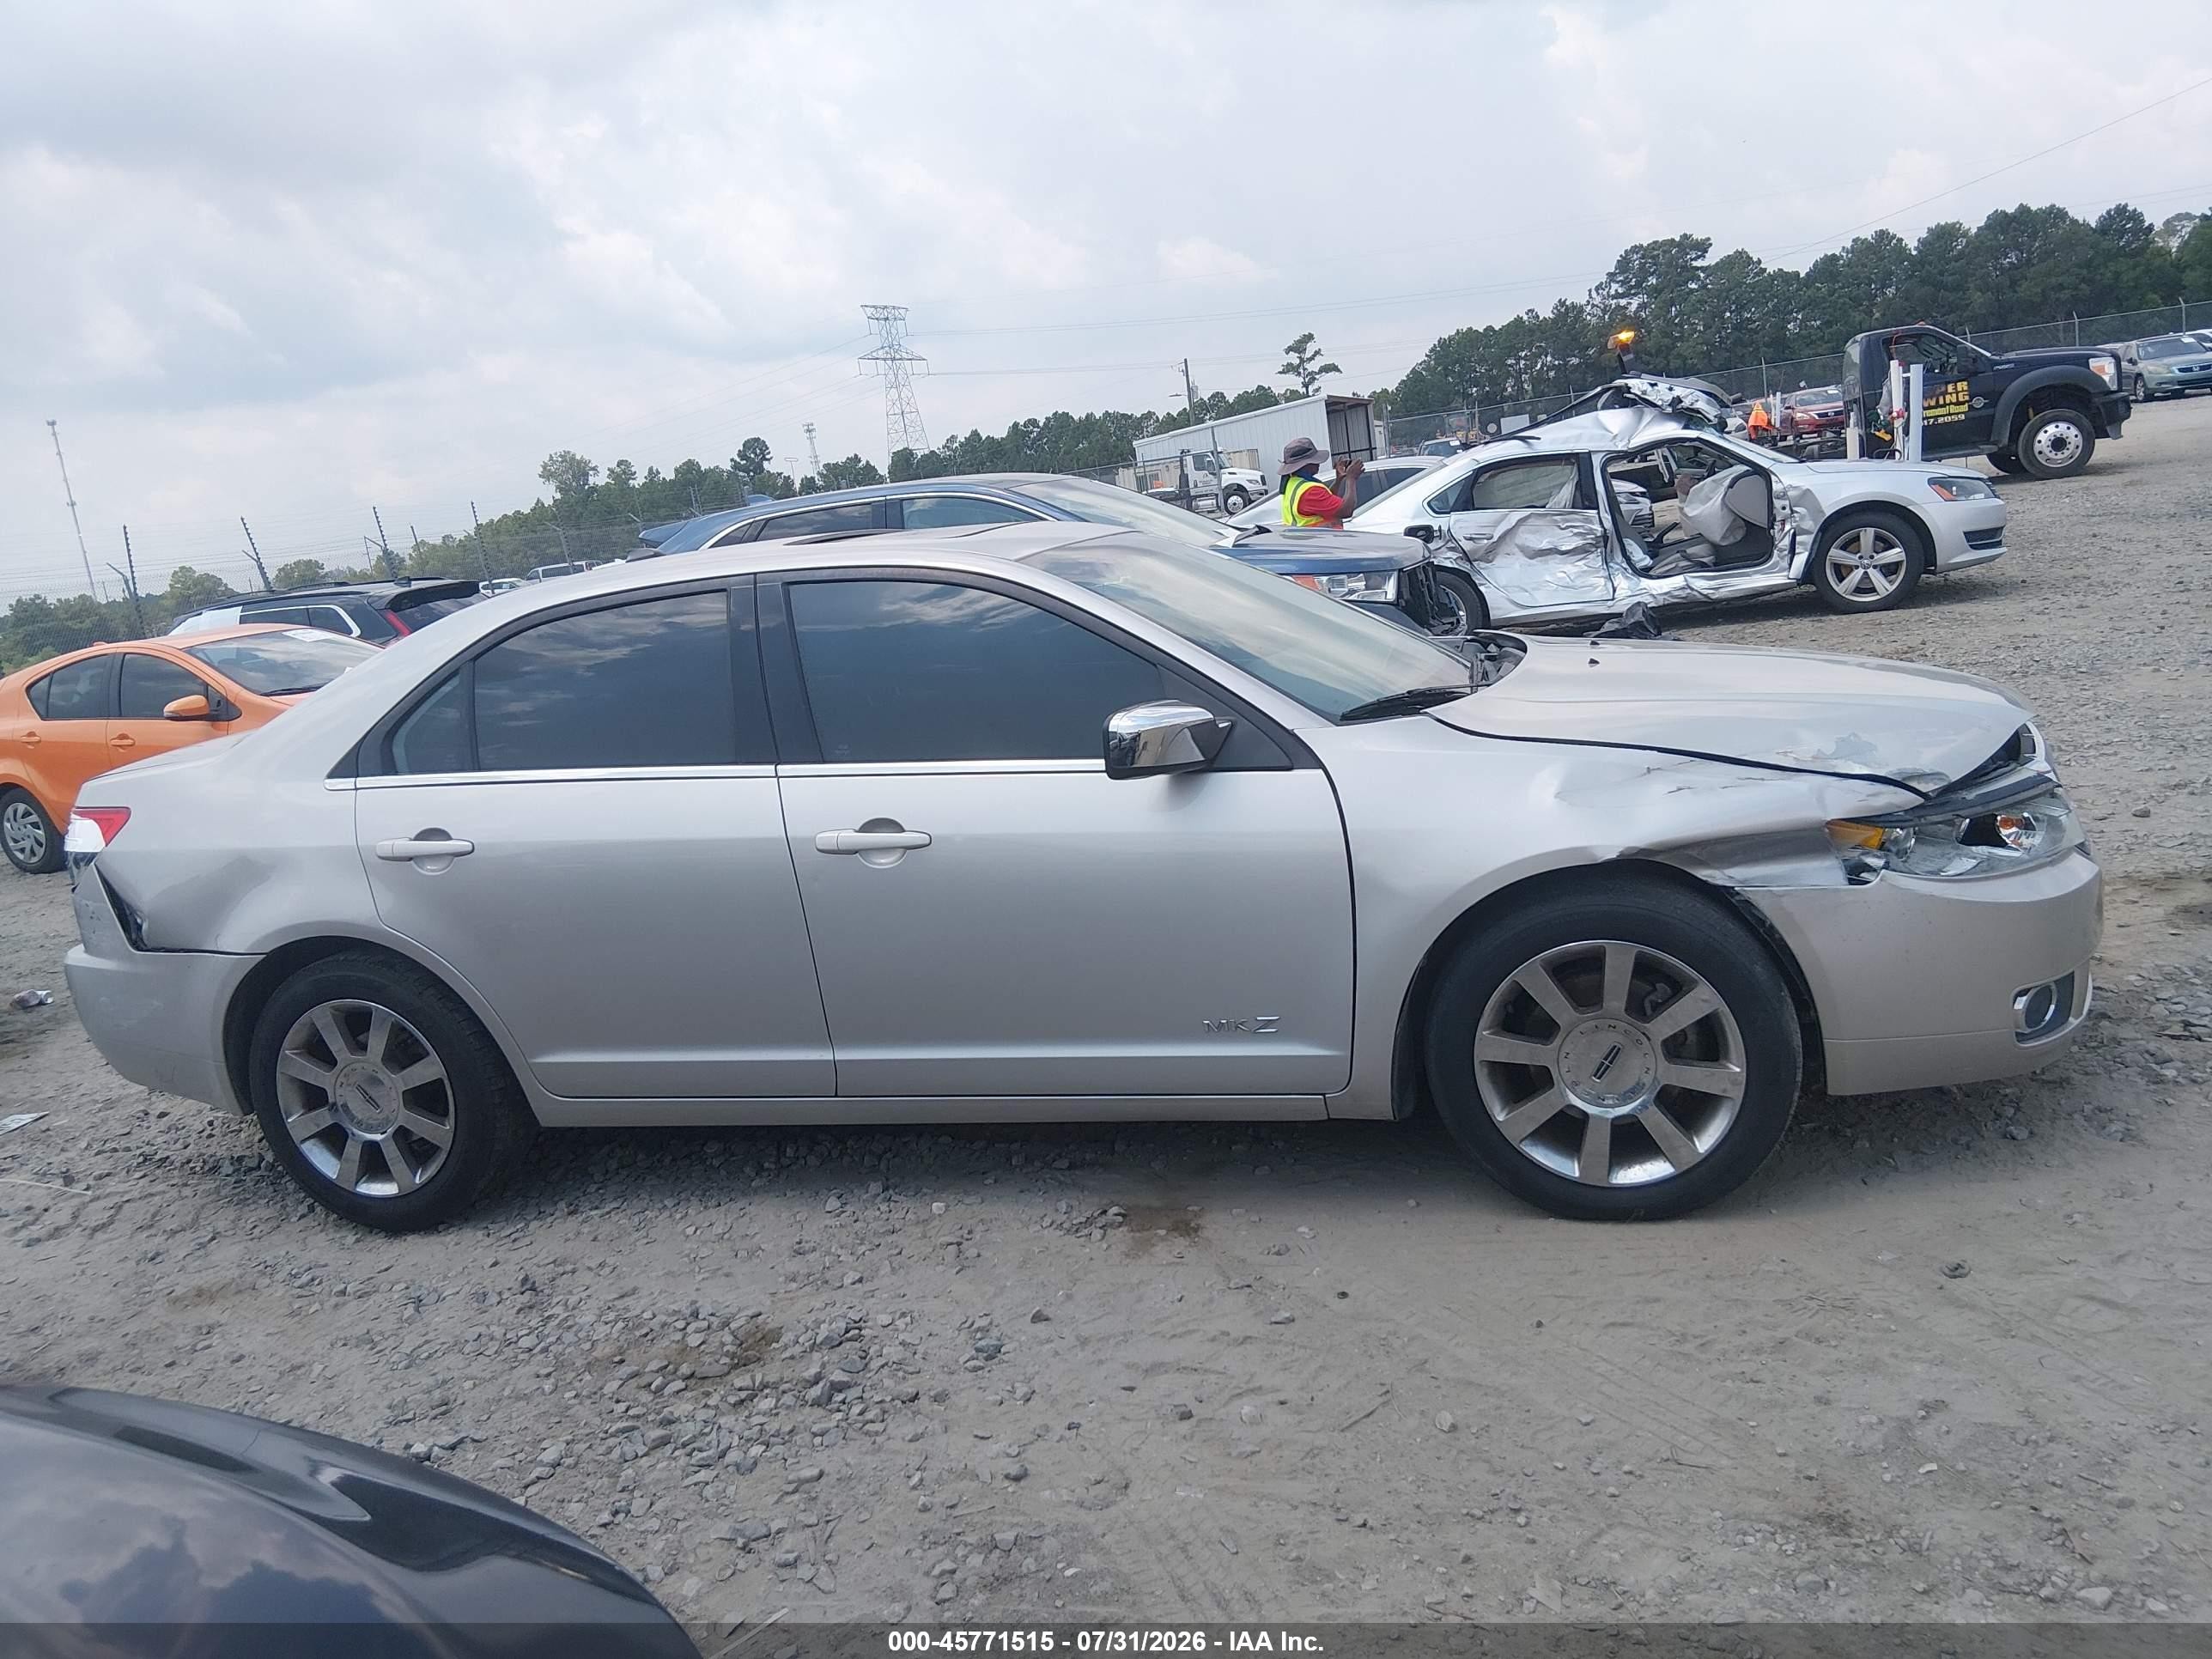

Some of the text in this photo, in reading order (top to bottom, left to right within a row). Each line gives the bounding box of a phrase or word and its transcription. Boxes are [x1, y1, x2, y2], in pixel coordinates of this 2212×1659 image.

[1923, 392, 1969, 406] WING
[1949, 402, 1968, 413] Road
[1923, 414, 1965, 426] 17.2059
[1202, 1016, 1280, 1033] MKZ
